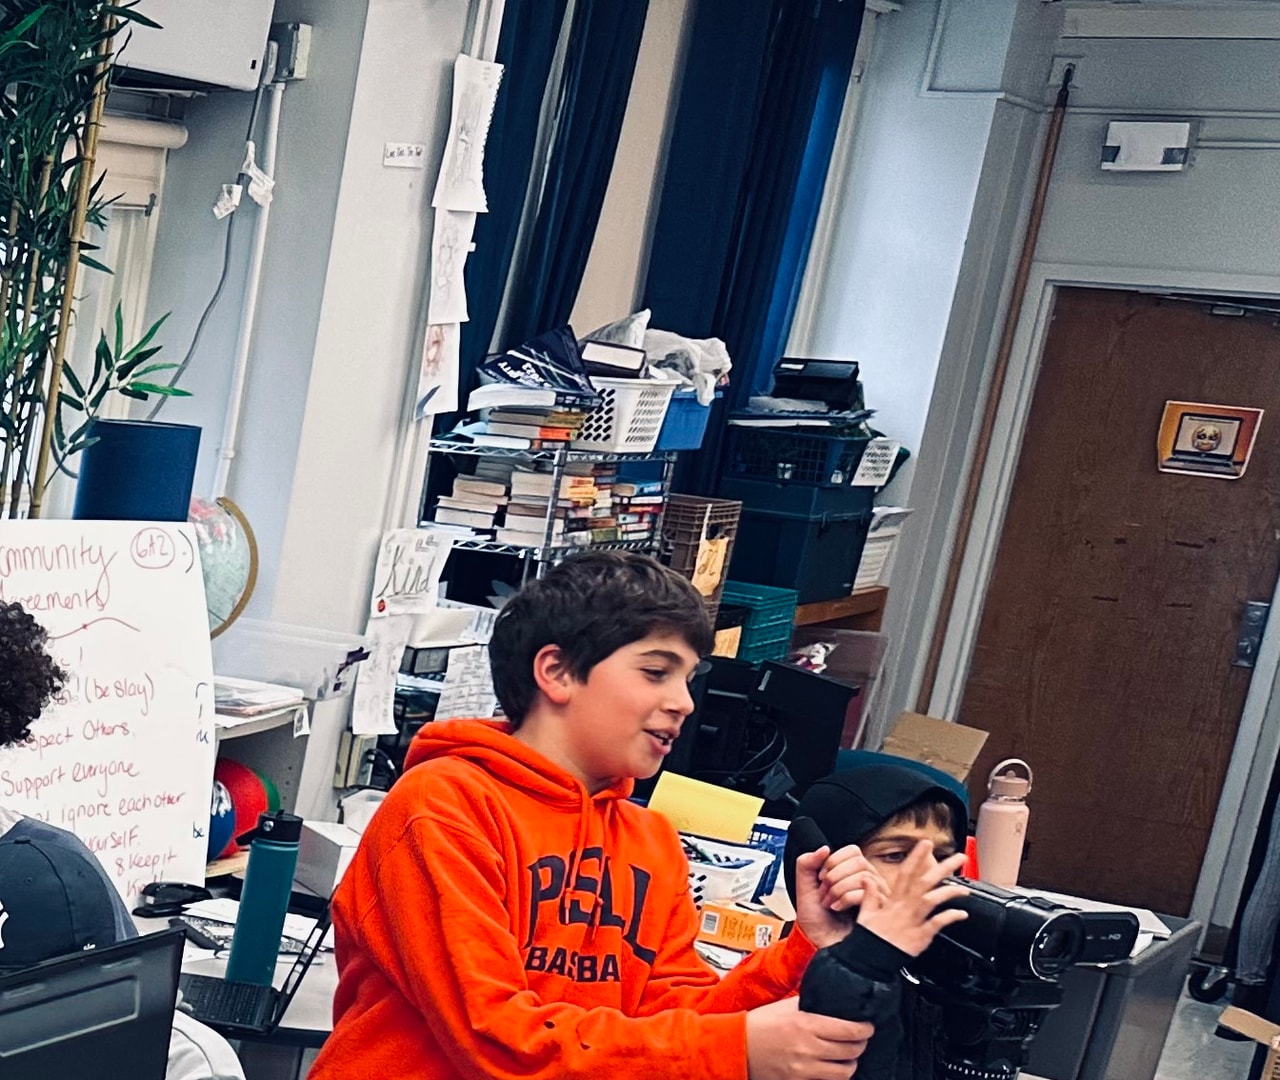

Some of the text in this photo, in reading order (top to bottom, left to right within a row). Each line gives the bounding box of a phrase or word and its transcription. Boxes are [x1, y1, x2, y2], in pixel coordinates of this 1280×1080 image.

[1, 766, 66, 799] Support
[72, 761, 140, 797] everyone
[61, 801, 112, 831] ignore
[522, 846, 657, 967] PELL
